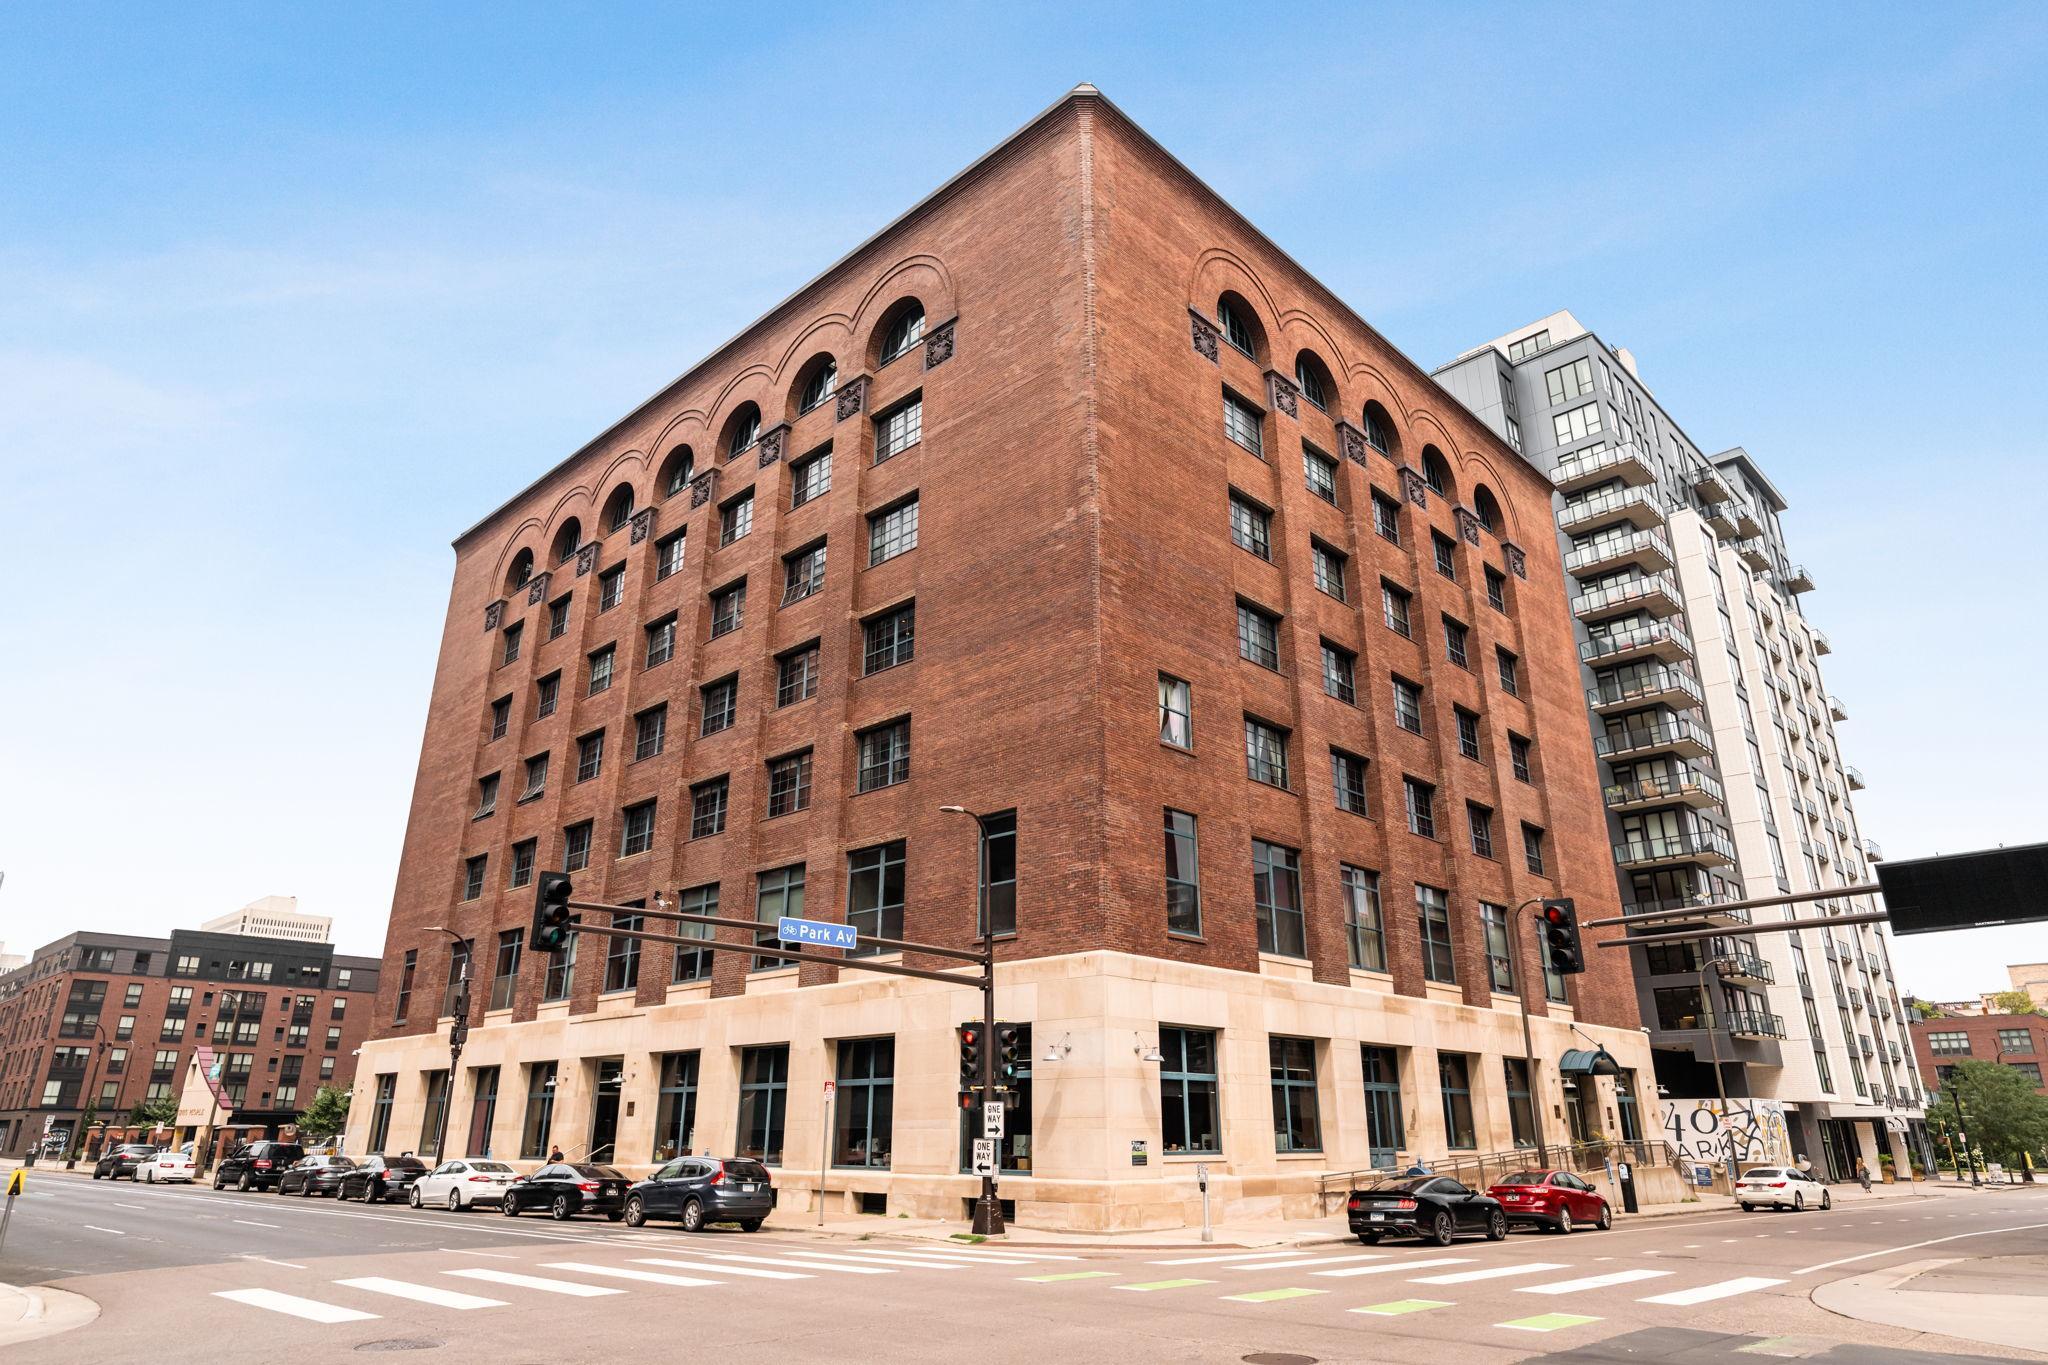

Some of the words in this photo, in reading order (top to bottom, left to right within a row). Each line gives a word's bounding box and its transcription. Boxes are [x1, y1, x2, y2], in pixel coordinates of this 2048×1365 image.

[800, 924, 830, 940] Park
[836, 930, 853, 943] Av
[987, 1105, 1000, 1114] ONE
[987, 1114, 1000, 1123] WAY
[976, 1142, 990, 1151] ONE
[976, 1152, 990, 1161] WAY
